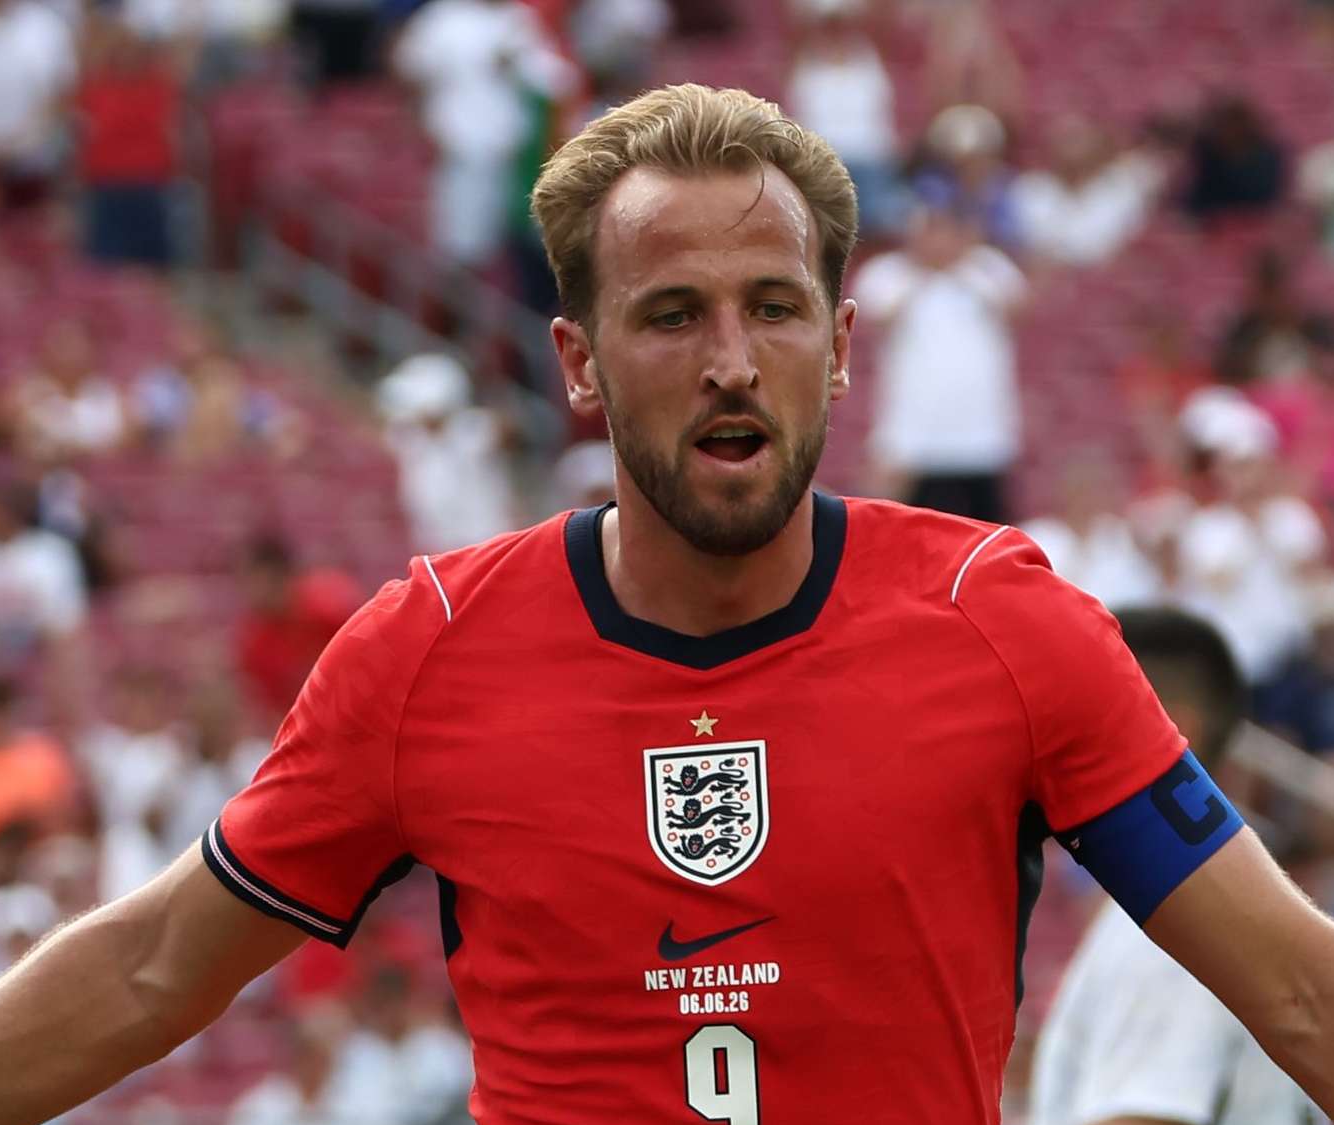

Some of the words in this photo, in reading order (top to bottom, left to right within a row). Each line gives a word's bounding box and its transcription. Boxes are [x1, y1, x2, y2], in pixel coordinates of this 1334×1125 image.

[644, 969, 686, 991] NEW
[692, 963, 780, 988] ZEALAND
[679, 991, 749, 1014] 06.06.26
